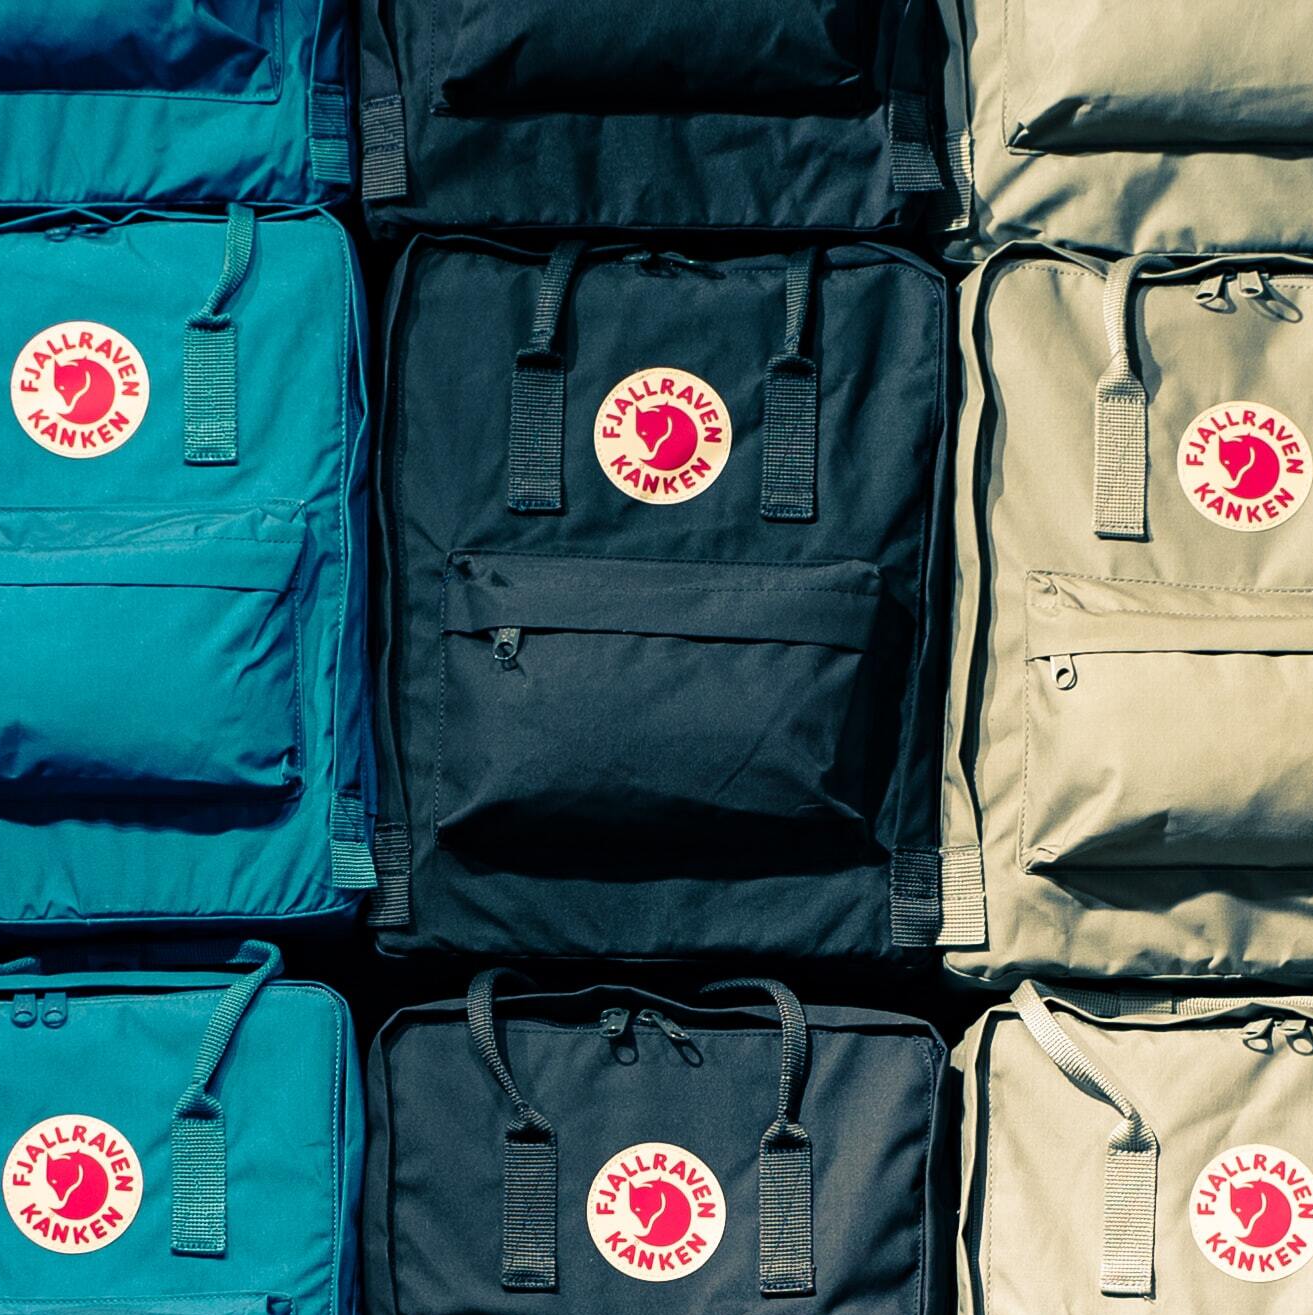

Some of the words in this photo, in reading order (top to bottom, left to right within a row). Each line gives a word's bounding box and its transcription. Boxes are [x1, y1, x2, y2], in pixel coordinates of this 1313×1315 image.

[20, 332, 140, 396] FJALLRAVEN
[602, 378, 722, 443] FJALLRAVEN
[1186, 410, 1304, 474] FJALLRAVEN
[13, 1125, 134, 1192] FJALLRAVEN
[596, 1153, 716, 1218] FJALLRAVEN
